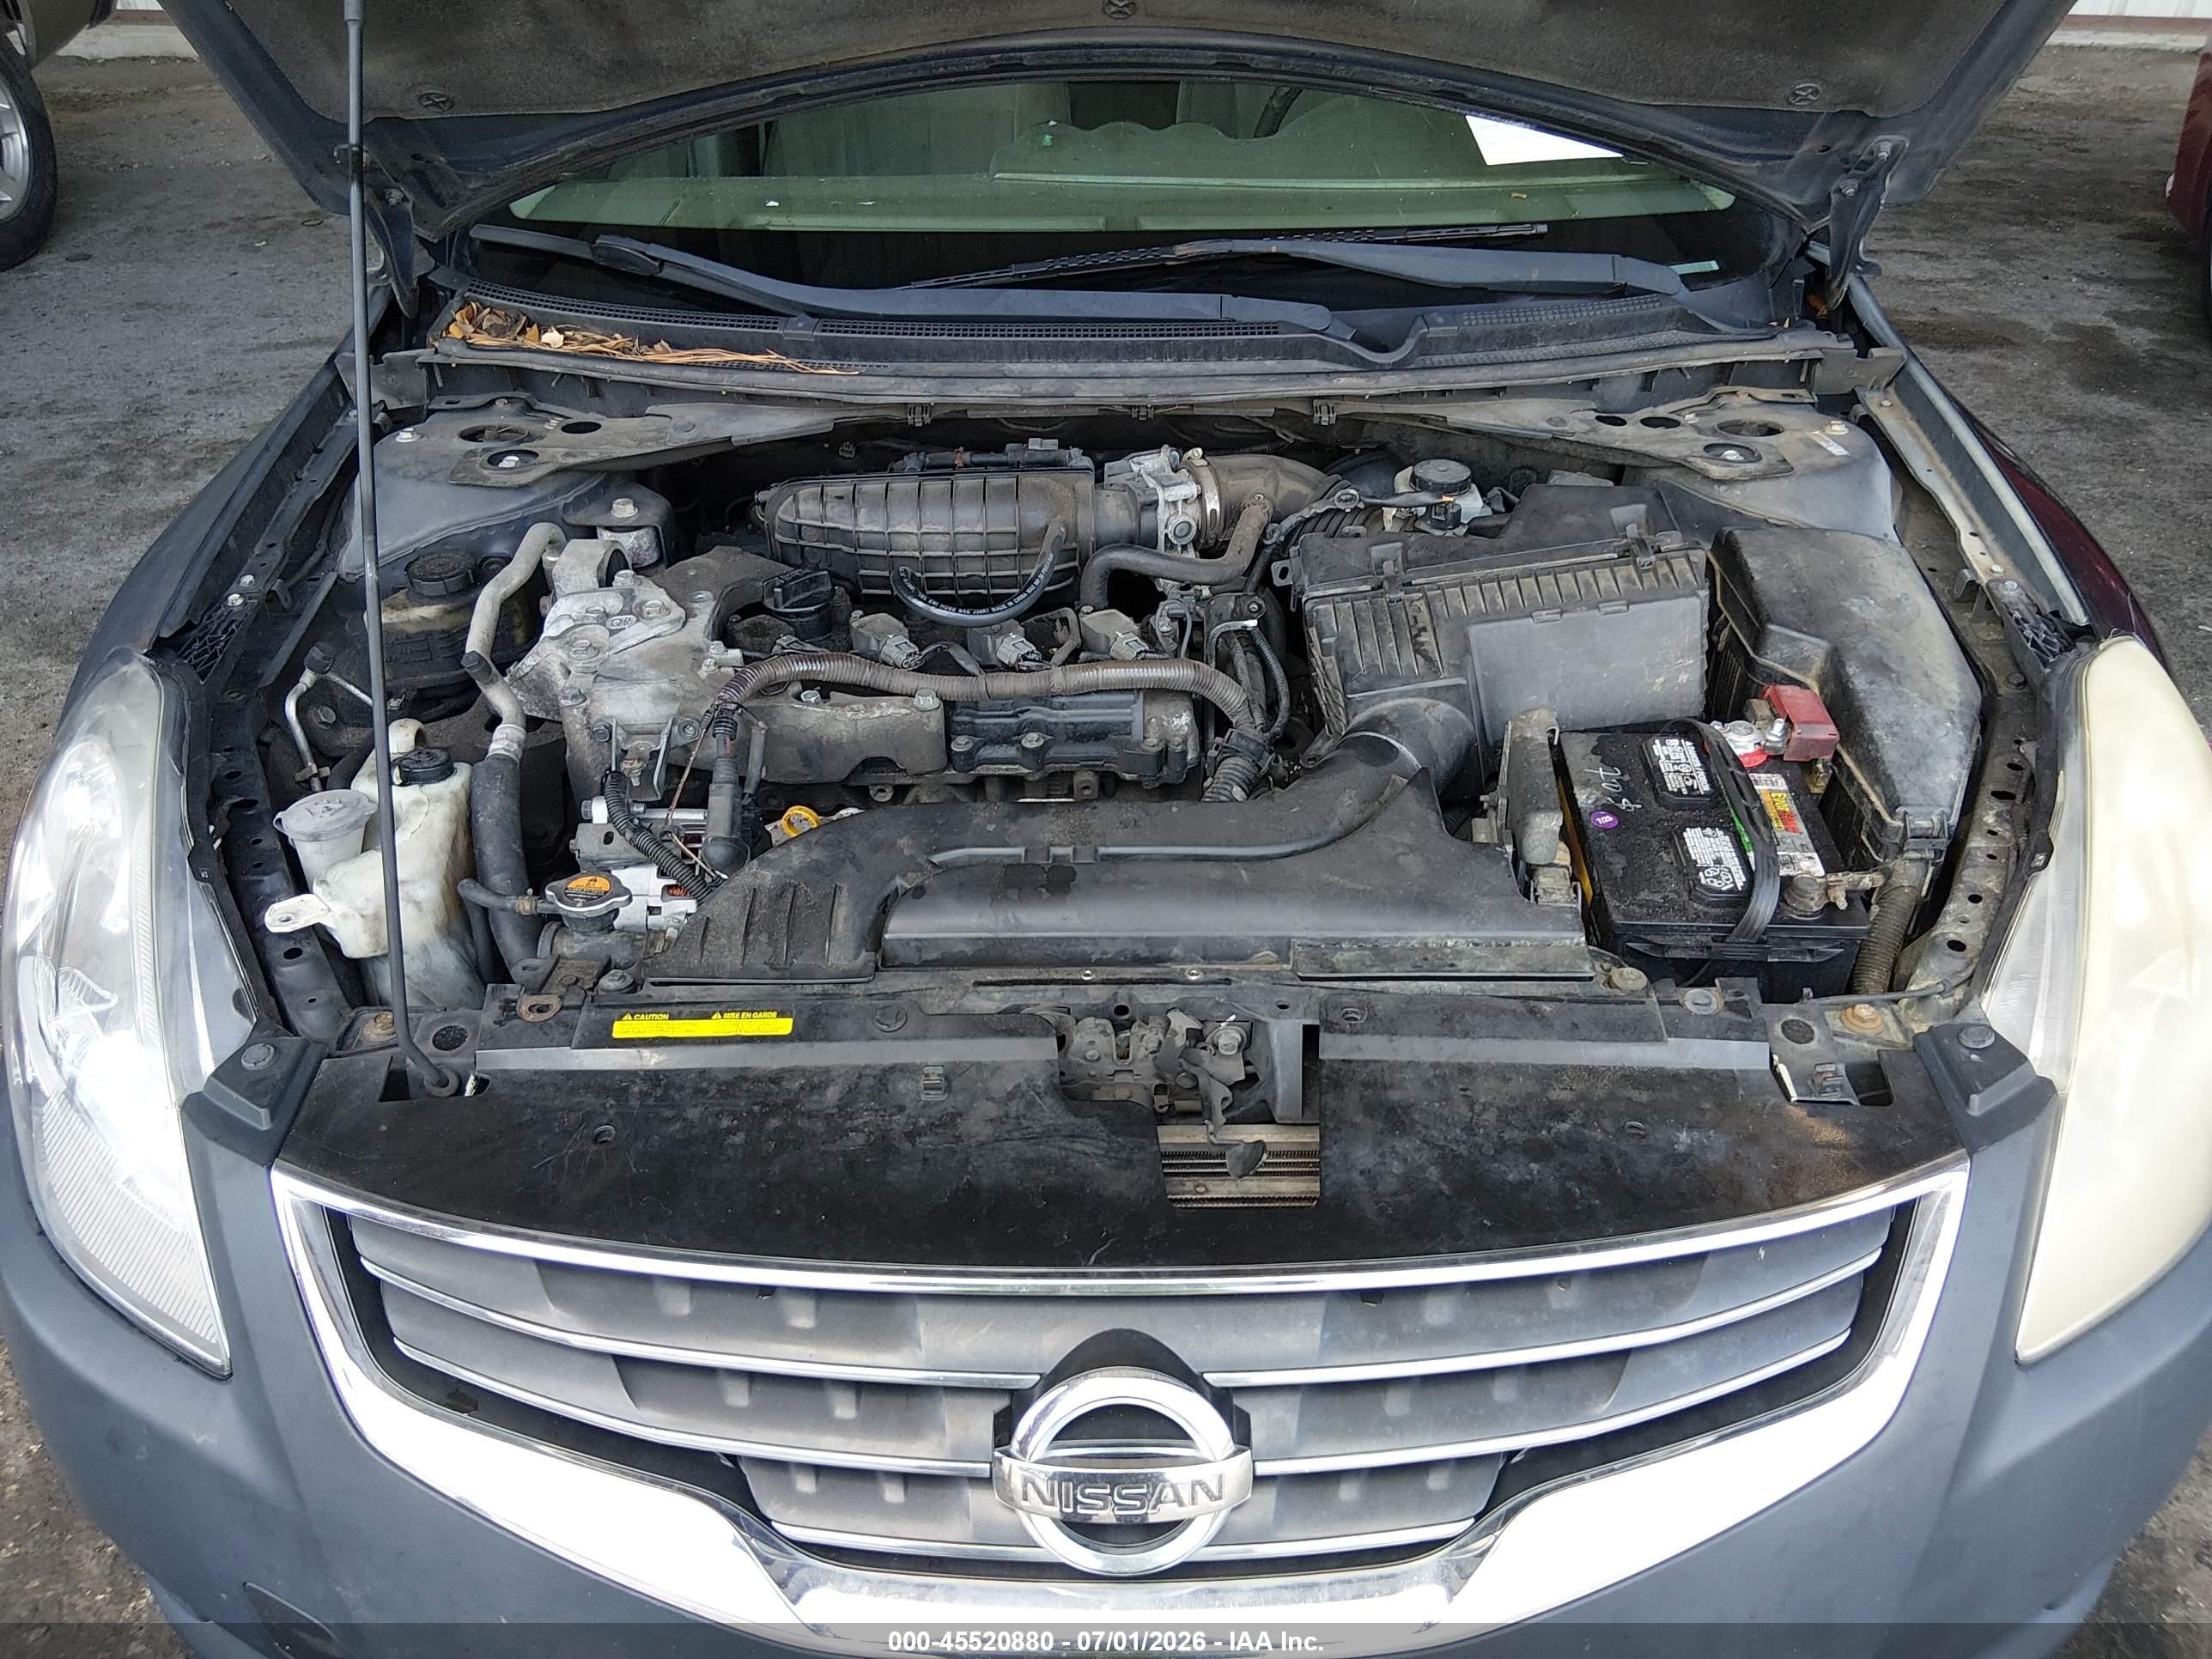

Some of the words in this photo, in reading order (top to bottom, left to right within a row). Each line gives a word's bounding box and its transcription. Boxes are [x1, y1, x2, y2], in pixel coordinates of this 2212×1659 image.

[939, 604, 957, 612] HOSE
[991, 604, 1008, 612] MADE
[1013, 592, 1029, 604] CHINA
[1021, 1472, 1225, 1516] NISSAN
